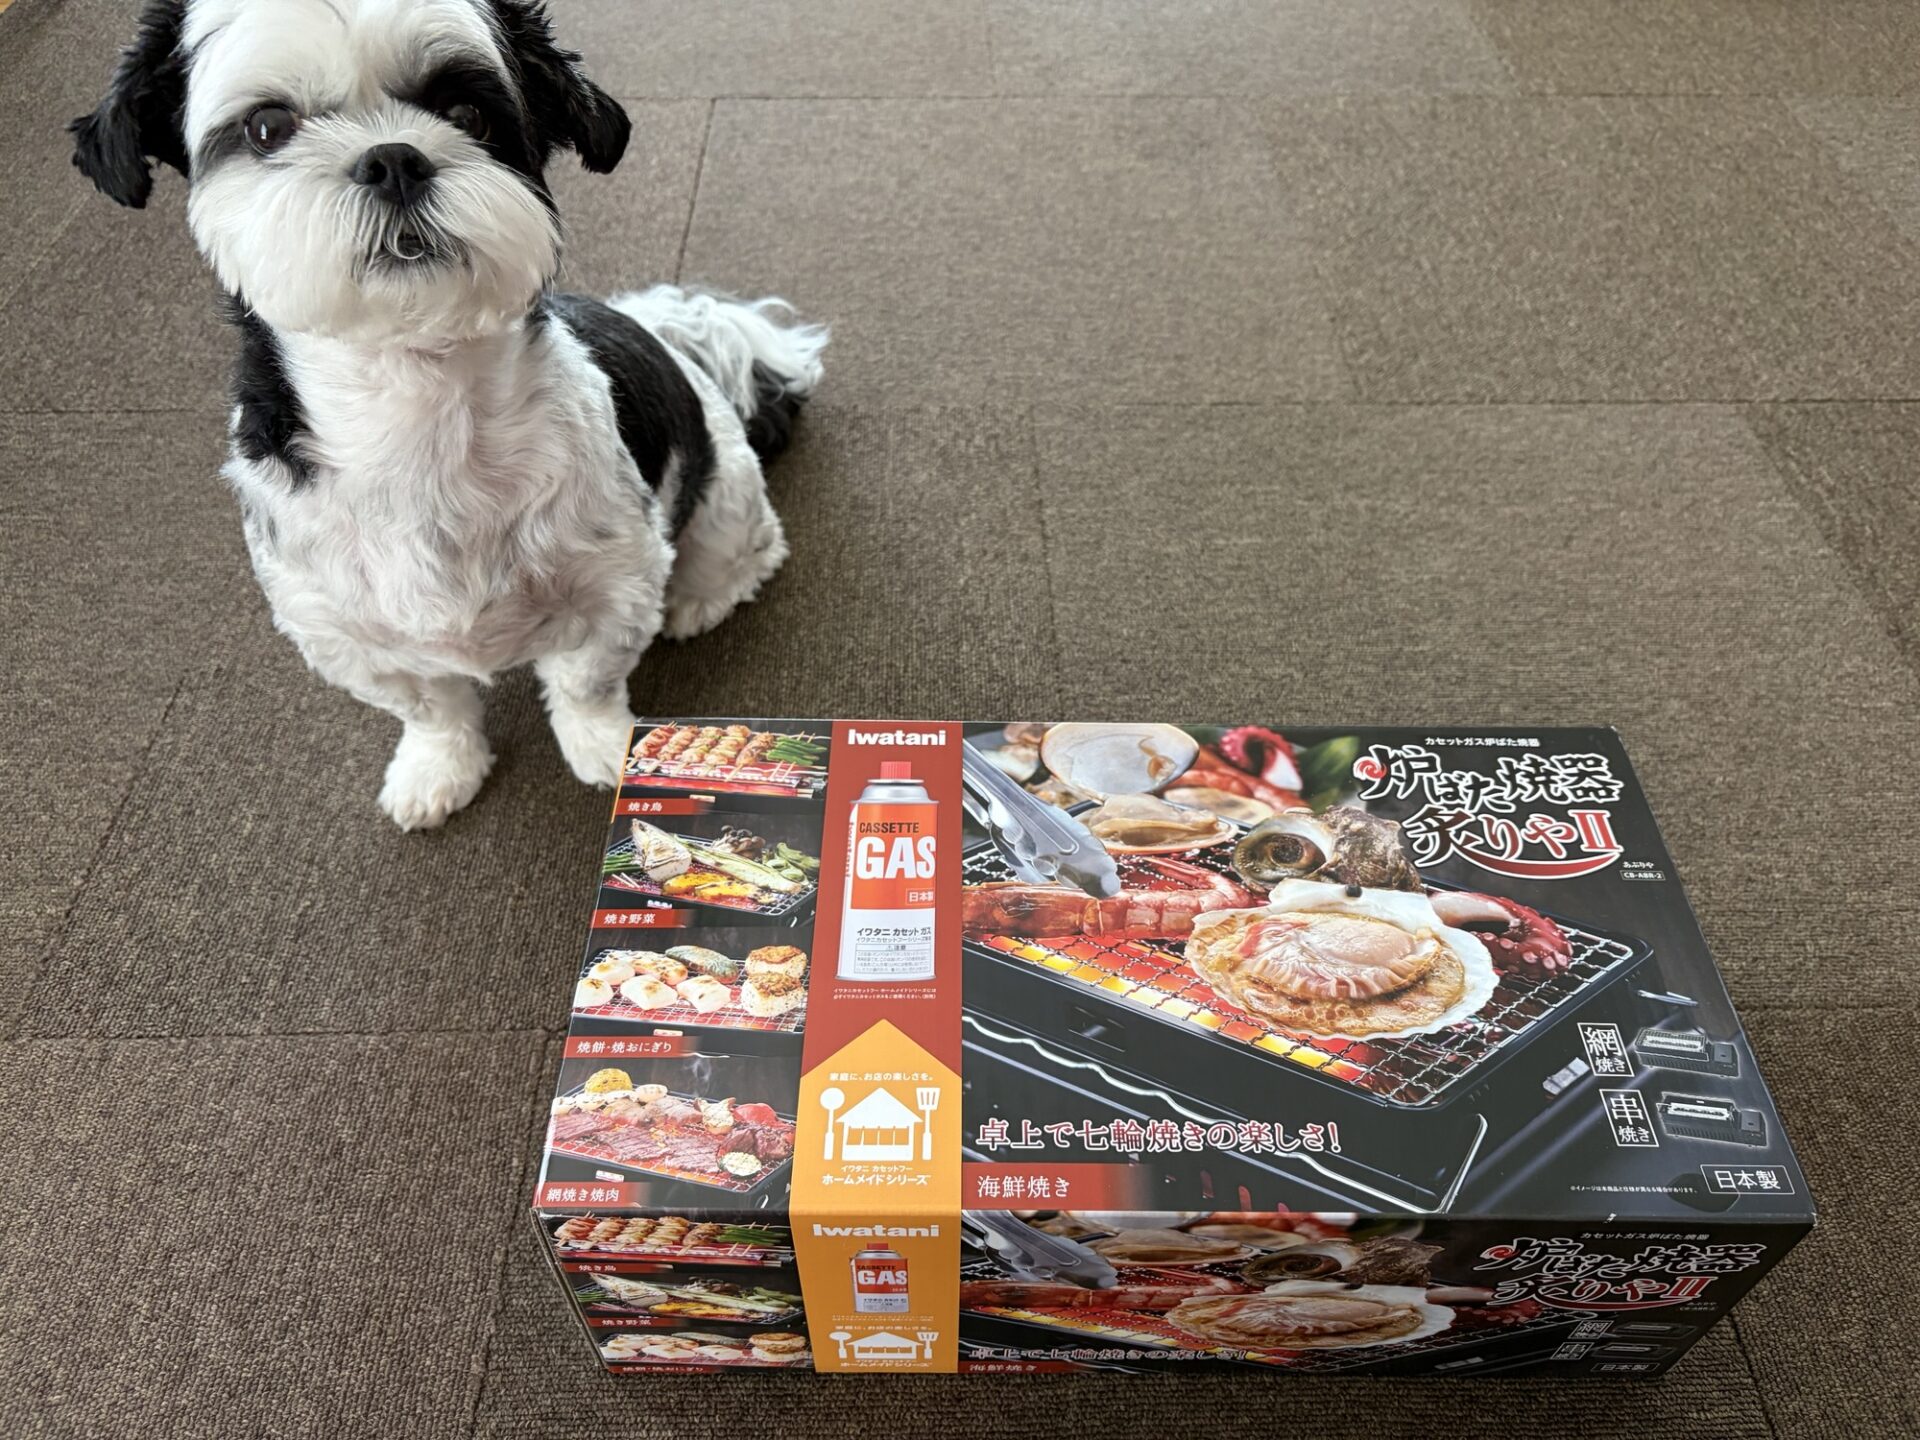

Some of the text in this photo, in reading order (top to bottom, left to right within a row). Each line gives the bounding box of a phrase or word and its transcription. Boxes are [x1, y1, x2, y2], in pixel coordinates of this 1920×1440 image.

[848, 729, 946, 746] Iwatani
[1353, 744, 1624, 813] 炉ばた焼器
[627, 801, 663, 813] 焼き鳥
[859, 822, 919, 834] CASSETTE
[856, 835, 936, 880] GAS
[603, 912, 656, 926] 焼き野菜
[857, 927, 891, 937] イワタニ
[893, 926, 919, 936] カセット
[1584, 1026, 1623, 1057] 網
[1595, 1056, 1625, 1074] 焼き
[1611, 1093, 1645, 1126] 串
[975, 1117, 1343, 1154] 卓上で七輪焼きの楽しさ!
[1618, 1124, 1650, 1144] 焼き
[841, 1164, 914, 1173] イワタニ カセットフー
[822, 1173, 931, 1186] ホームメイドシリーズ
[976, 1174, 1071, 1199] 海鮮焼き
[1714, 1169, 1782, 1191] 日本製
[545, 1186, 620, 1203] 網焼き焼肉
[812, 1223, 940, 1237] Iwatani
[1473, 1237, 1768, 1279] 炉ばた焼器
[857, 1270, 908, 1286] GAS
